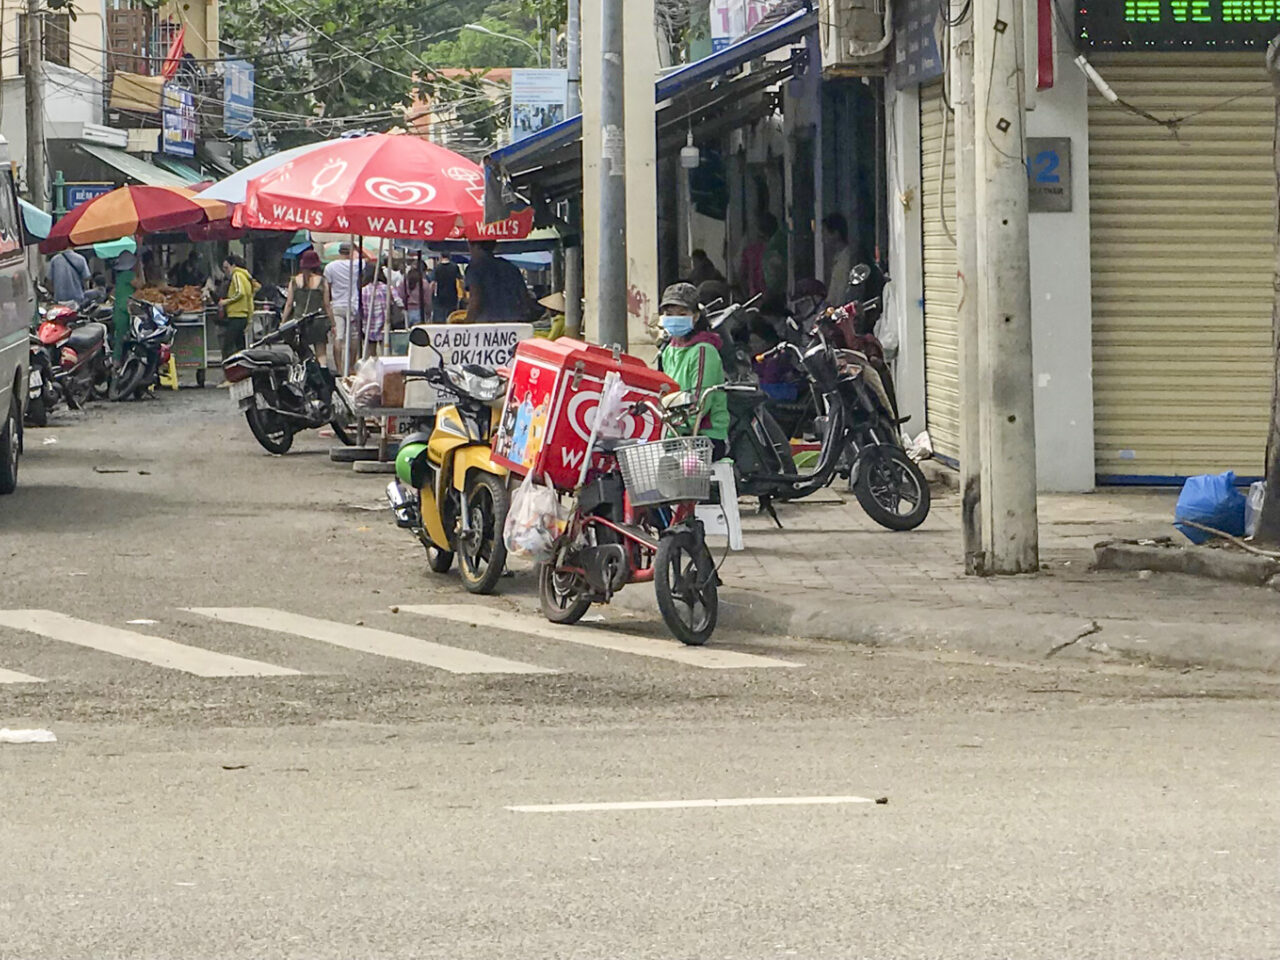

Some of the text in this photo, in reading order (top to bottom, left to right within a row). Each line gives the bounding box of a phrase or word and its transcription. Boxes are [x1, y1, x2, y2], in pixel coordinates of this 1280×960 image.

[1026, 150, 1060, 183] 2
[273, 203, 323, 226] WALL'S
[367, 215, 434, 236] WALL'S
[476, 220, 519, 235] WALL'S
[434, 329, 450, 348] CÁ
[474, 332, 480, 347] 1
